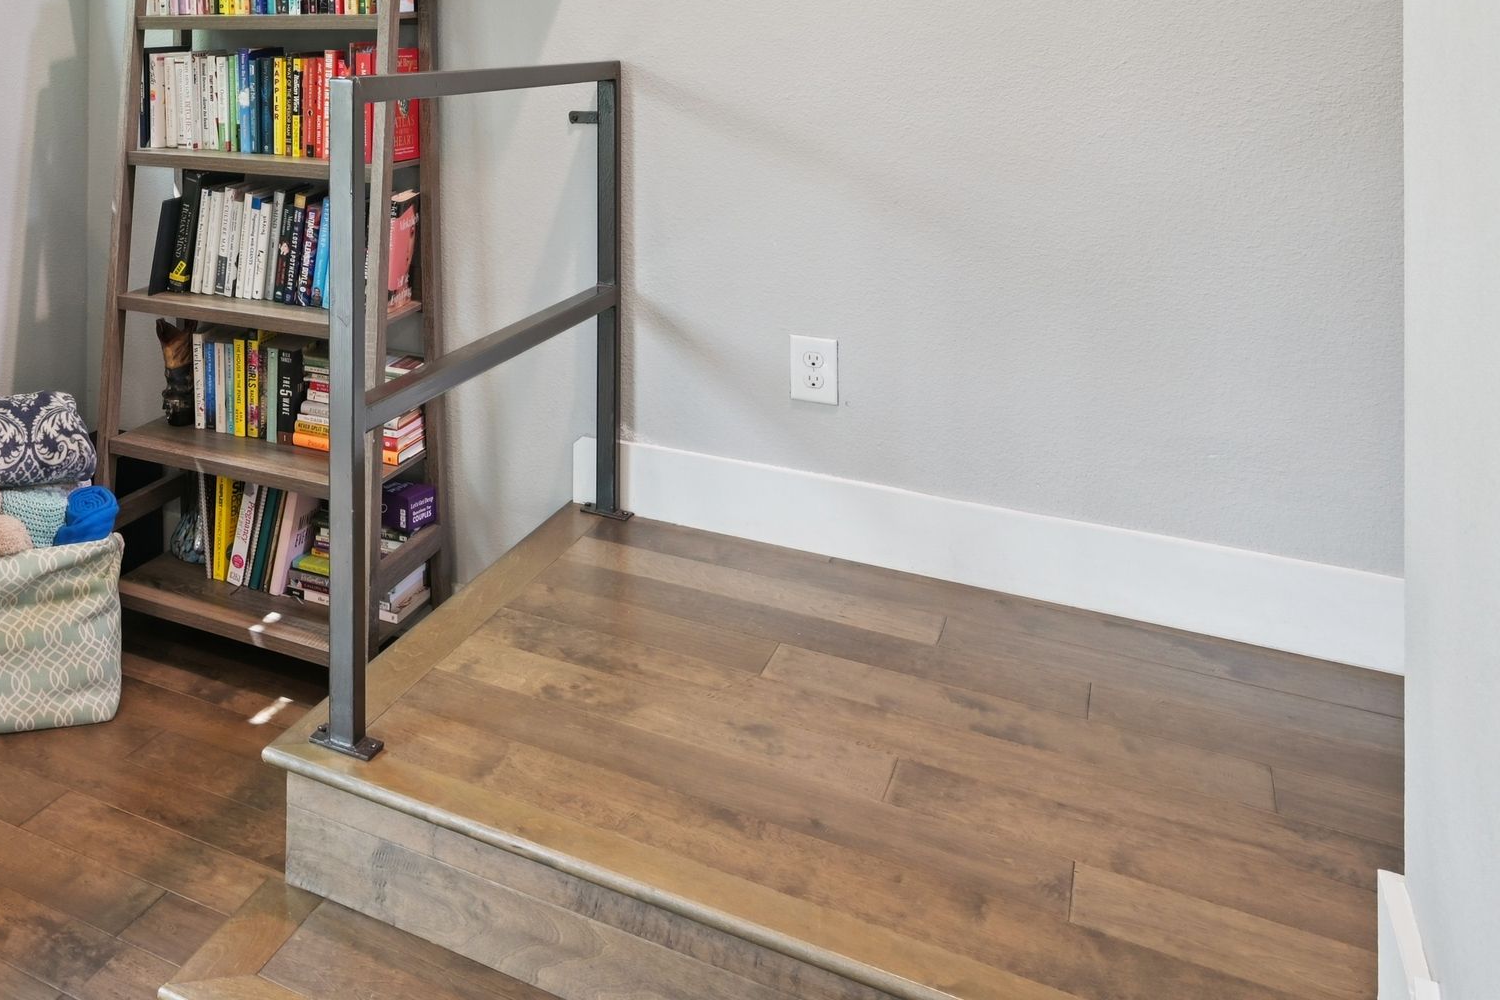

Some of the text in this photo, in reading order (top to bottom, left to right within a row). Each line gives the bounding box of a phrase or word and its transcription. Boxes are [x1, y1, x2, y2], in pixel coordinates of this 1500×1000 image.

[393, 135, 414, 148] HEART
[174, 203, 190, 258] HUMAN MIND
[222, 205, 231, 235] CULTURE
[307, 211, 316, 238] UNTAMED
[320, 223, 328, 248] SHARP
[286, 232, 299, 291] LOST APOTHECARY
[303, 241, 312, 266] GLENNON
[194, 343, 202, 372] Twelve
[248, 364, 257, 388] GIRLS
[282, 376, 291, 388] THE
[282, 398, 291, 416] WAVE
[298, 422, 310, 430] NEVER
[311, 423, 322, 432] SPLIT
[410, 501, 419, 510] Let's
[412, 510, 432, 523] COUPLES
[241, 501, 255, 544] Pregnancy
